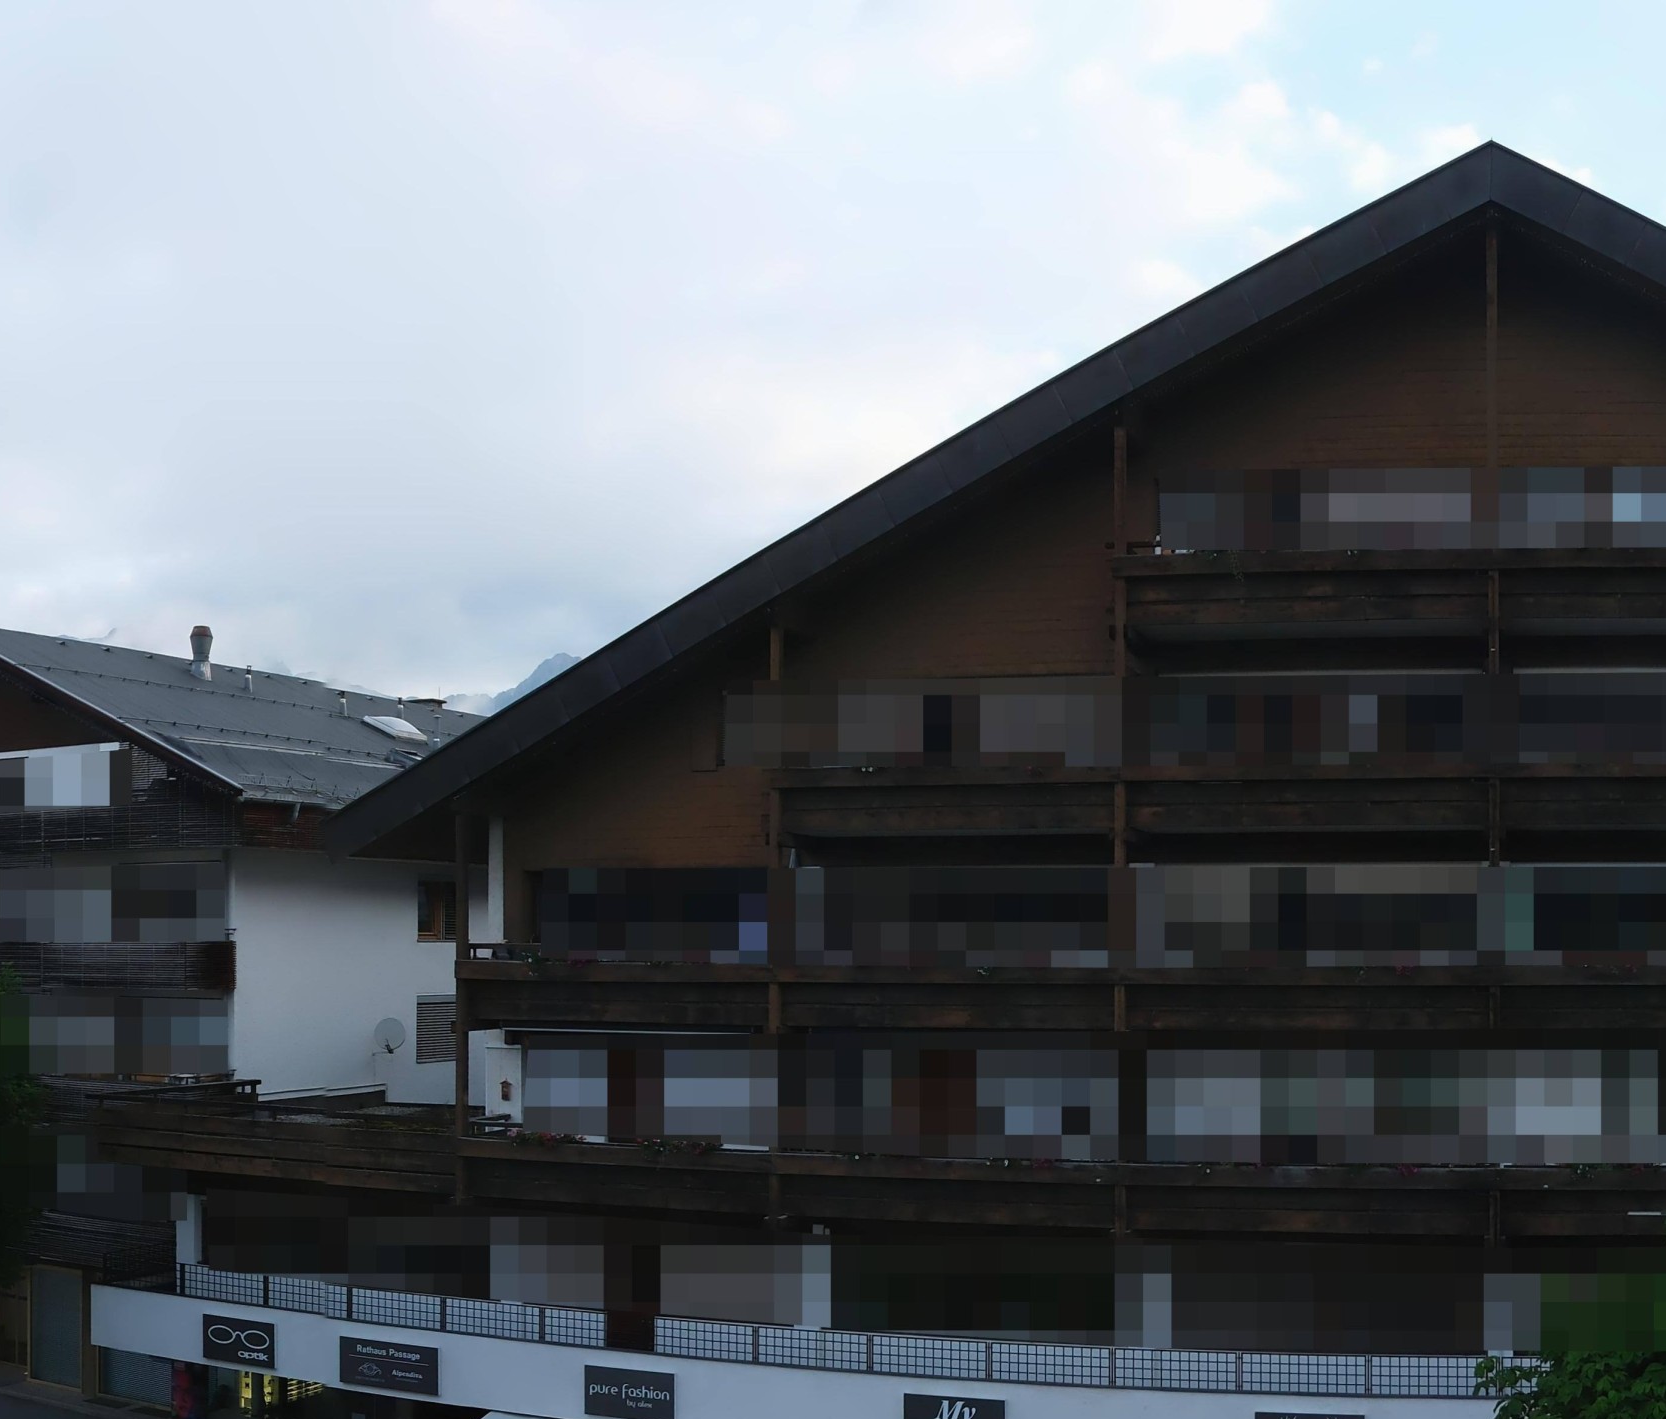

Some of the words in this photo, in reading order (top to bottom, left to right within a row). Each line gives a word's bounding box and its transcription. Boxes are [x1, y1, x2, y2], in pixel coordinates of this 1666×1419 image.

[237, 1350, 269, 1362] optik
[356, 1344, 386, 1356] Rathaus
[388, 1348, 421, 1361] Passage
[589, 1383, 619, 1396] pure
[622, 1383, 670, 1400] fashion
[627, 1399, 636, 1408] by
